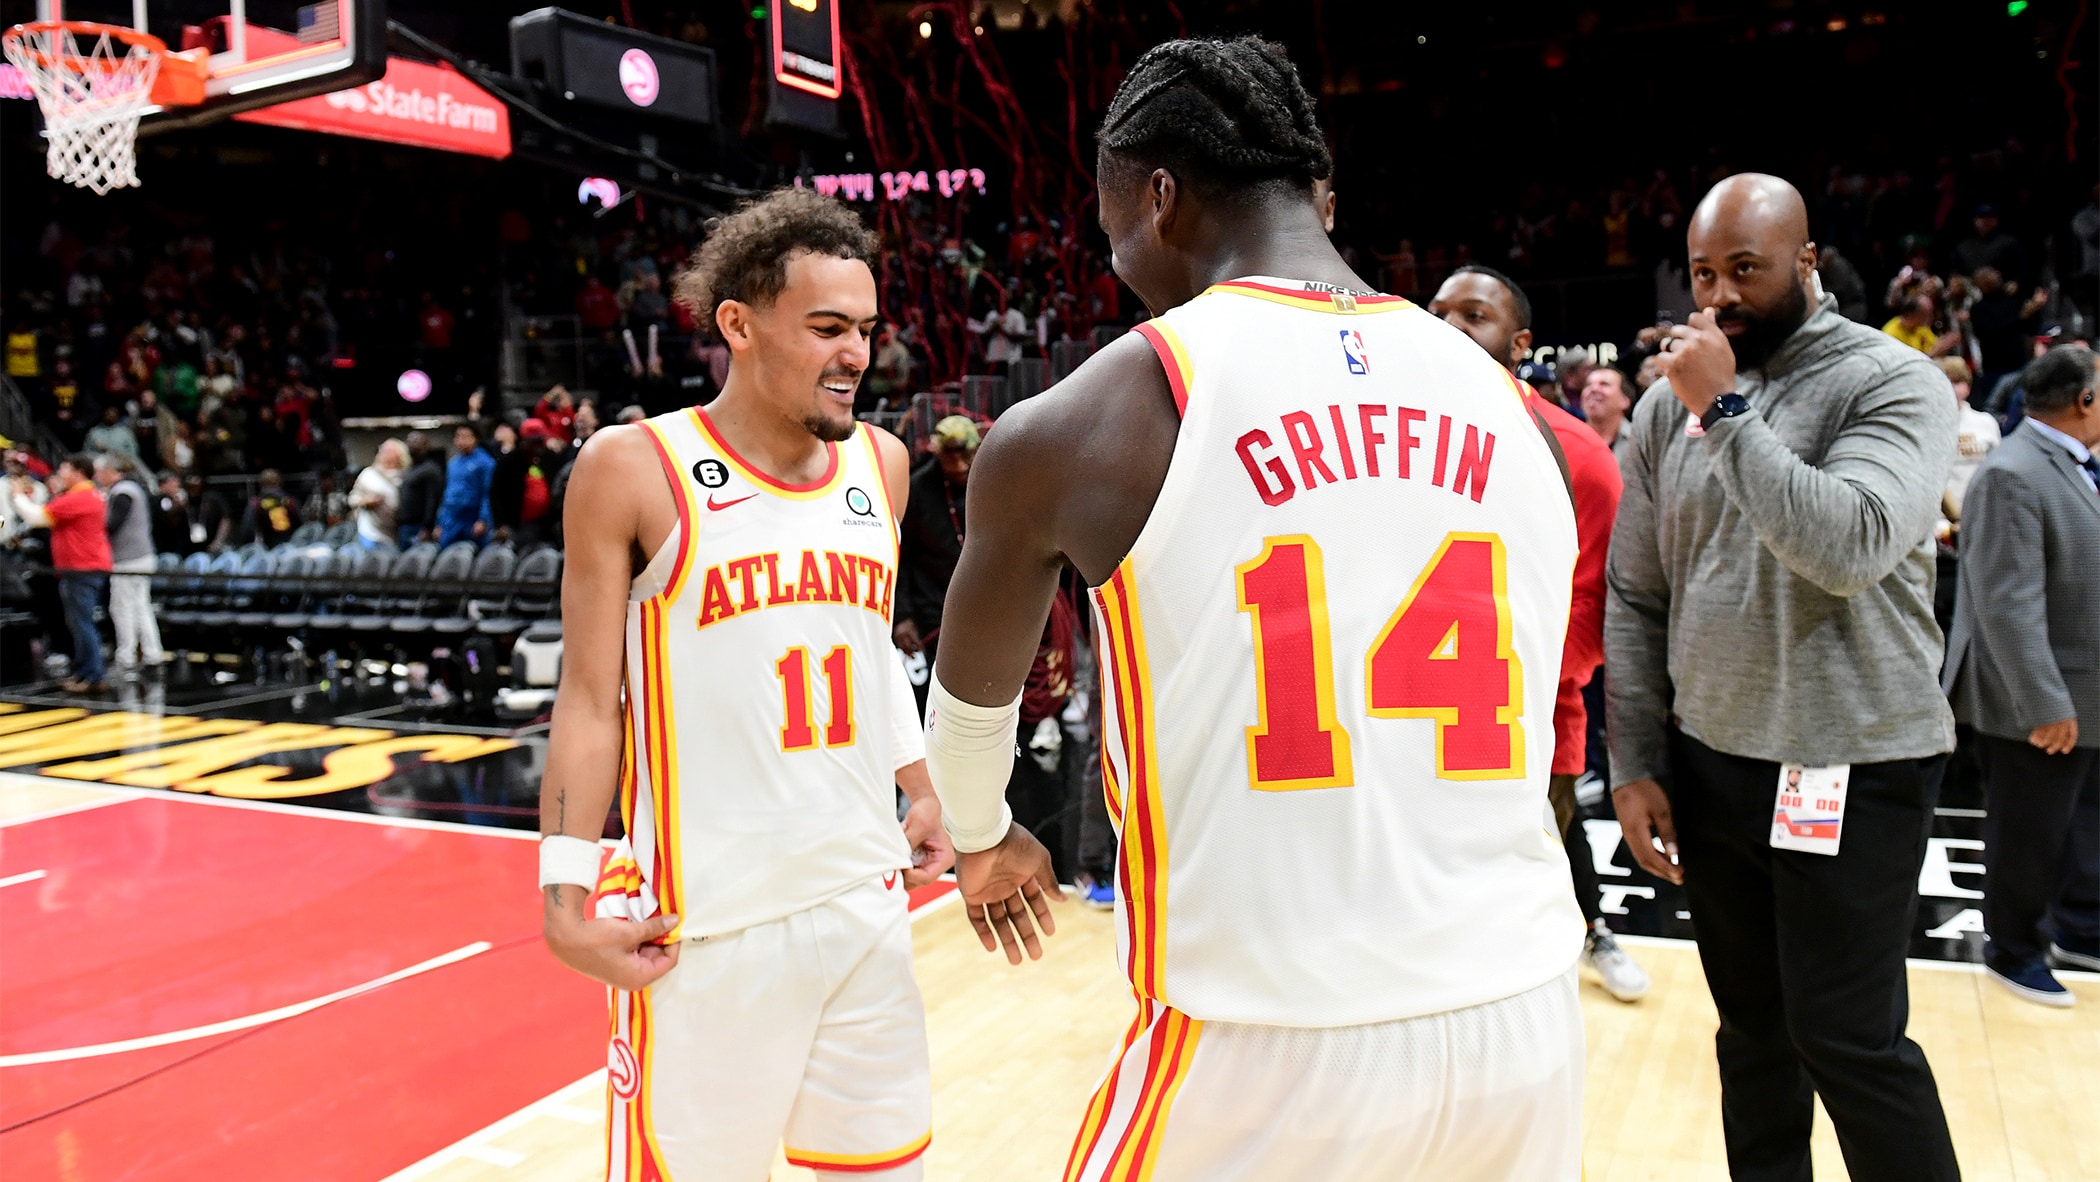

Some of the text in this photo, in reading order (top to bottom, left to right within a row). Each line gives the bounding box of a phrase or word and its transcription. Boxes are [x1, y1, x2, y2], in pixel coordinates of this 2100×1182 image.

[698, 461, 723, 486] 6
[1235, 404, 1496, 507] GRIFFIN
[842, 517, 883, 528] sharecare
[696, 549, 893, 631] ATLANTA
[775, 643, 857, 753] 11
[1234, 531, 1526, 792] 14
